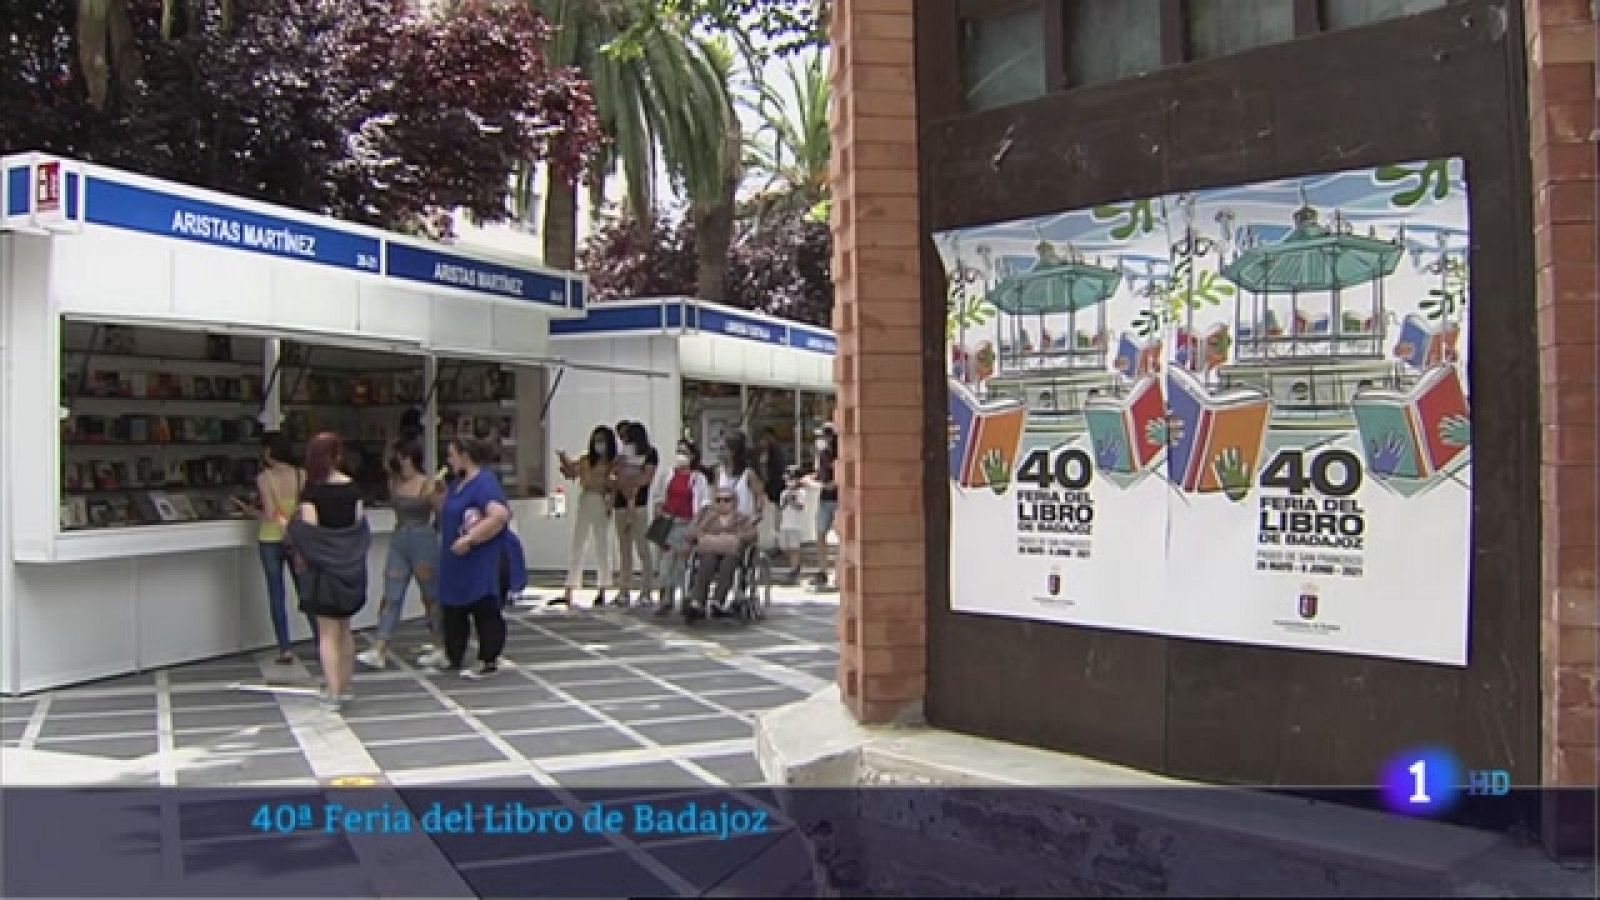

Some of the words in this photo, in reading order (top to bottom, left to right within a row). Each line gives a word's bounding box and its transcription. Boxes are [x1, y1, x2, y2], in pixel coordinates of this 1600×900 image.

[172, 210, 241, 242] ARISTAS
[243, 224, 316, 256] MARTÍNEZ
[1017, 449, 1093, 489] 40
[1260, 449, 1363, 496] 40
[1017, 490, 1060, 501] FERIA
[1064, 491, 1093, 503] DEL
[1260, 497, 1318, 511] FERIA
[1323, 499, 1364, 513] DEL
[1018, 502, 1094, 523] LIBRO
[1037, 523, 1092, 535] BADAJOZ
[1260, 511, 1365, 536] LIBRO
[1259, 533, 1281, 544] DE
[1285, 534, 1363, 550] BADAJOZ
